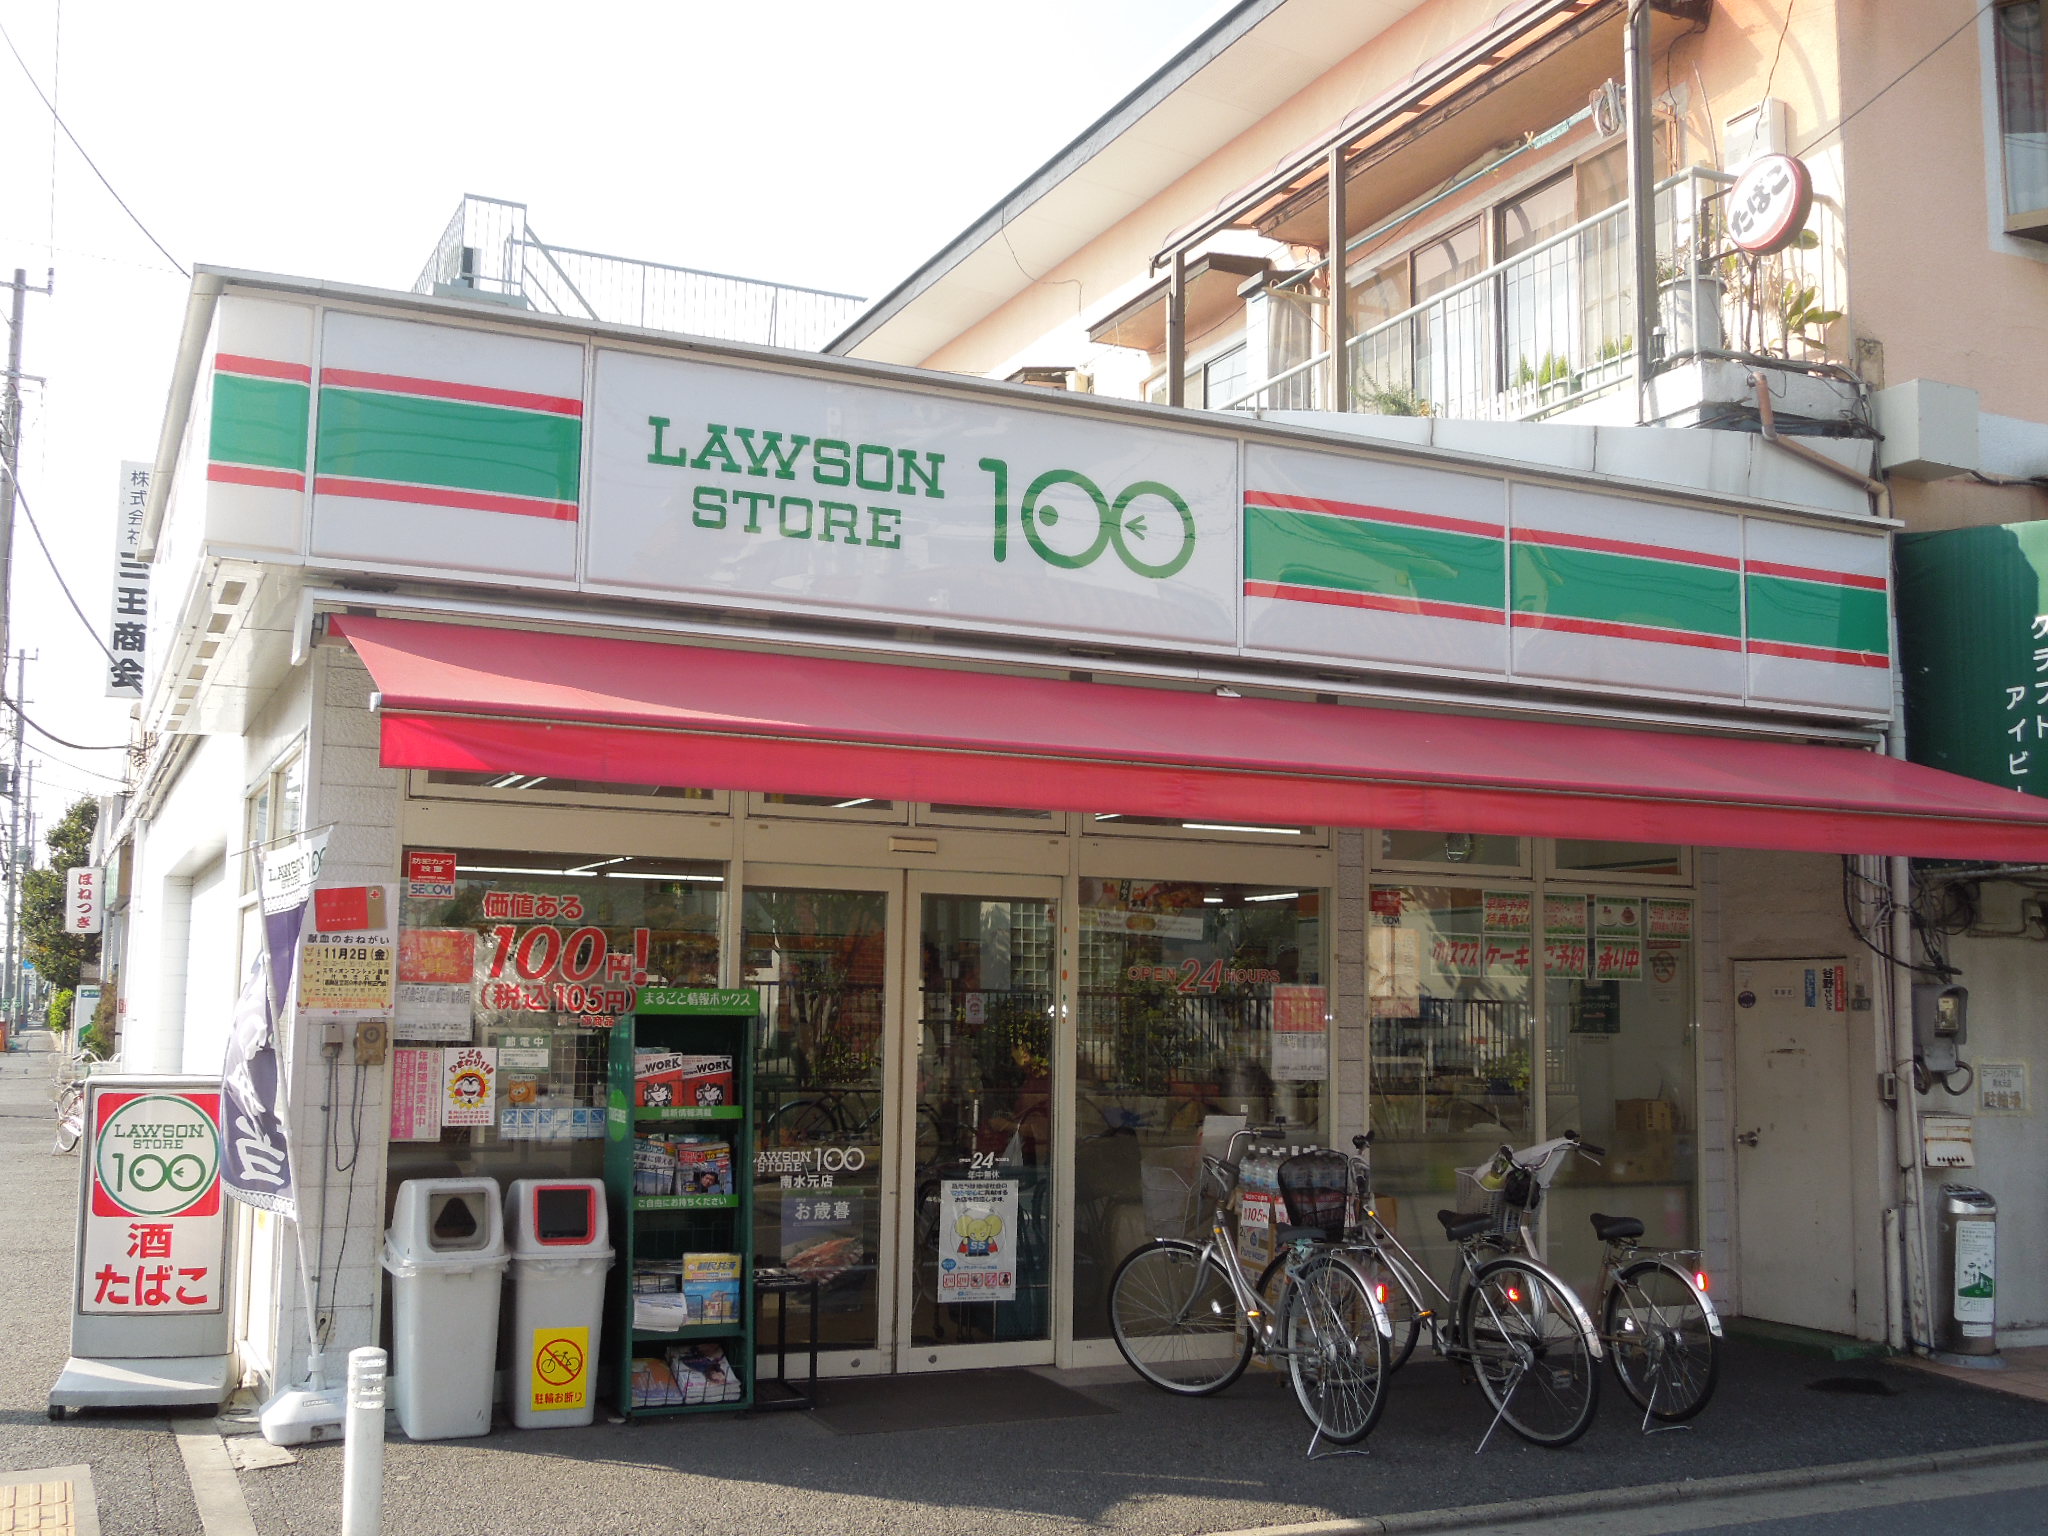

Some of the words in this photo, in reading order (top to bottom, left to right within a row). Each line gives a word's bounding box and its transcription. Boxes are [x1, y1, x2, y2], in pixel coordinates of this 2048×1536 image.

[1731, 164, 1790, 238] たばこ
[647, 415, 945, 499] LAWSON
[692, 485, 902, 550] STORE
[978, 457, 1196, 580] 100
[411, 883, 452, 895] SECOM
[77, 873, 93, 929] ほねつぎ
[482, 890, 584, 920] 価値ある
[307, 934, 390, 945] 献血のおねがい
[488, 924, 650, 988] 100円!
[1485, 943, 1530, 972] ケーキ
[1597, 945, 1641, 974] 承り中
[1127, 966, 1177, 982] OPEN
[1176, 957, 1224, 993] 24
[1224, 968, 1281, 984] HOURS
[480, 983, 638, 1014] (税込105円)
[643, 991, 751, 1006] まるごと情報ボックス
[458, 1048, 483, 1061] こども
[645, 1057, 682, 1073] WORK
[696, 1060, 732, 1074] WORK
[114, 1124, 205, 1138] LAWSON
[133, 1139, 184, 1149] STORE
[757, 1162, 802, 1173] STORE
[814, 1147, 866, 1172] 100
[970, 1151, 995, 1168] 24
[112, 1153, 206, 1192] 100
[780, 1174, 834, 1189] 南水元店
[638, 1196, 728, 1208] ご自由にお持ちください
[794, 1200, 851, 1220] お歳暮
[127, 1223, 174, 1259] 酒
[970, 1241, 986, 1250] SS
[95, 1263, 208, 1306] たばこ
[535, 1391, 583, 1405] 駐輪お断り
